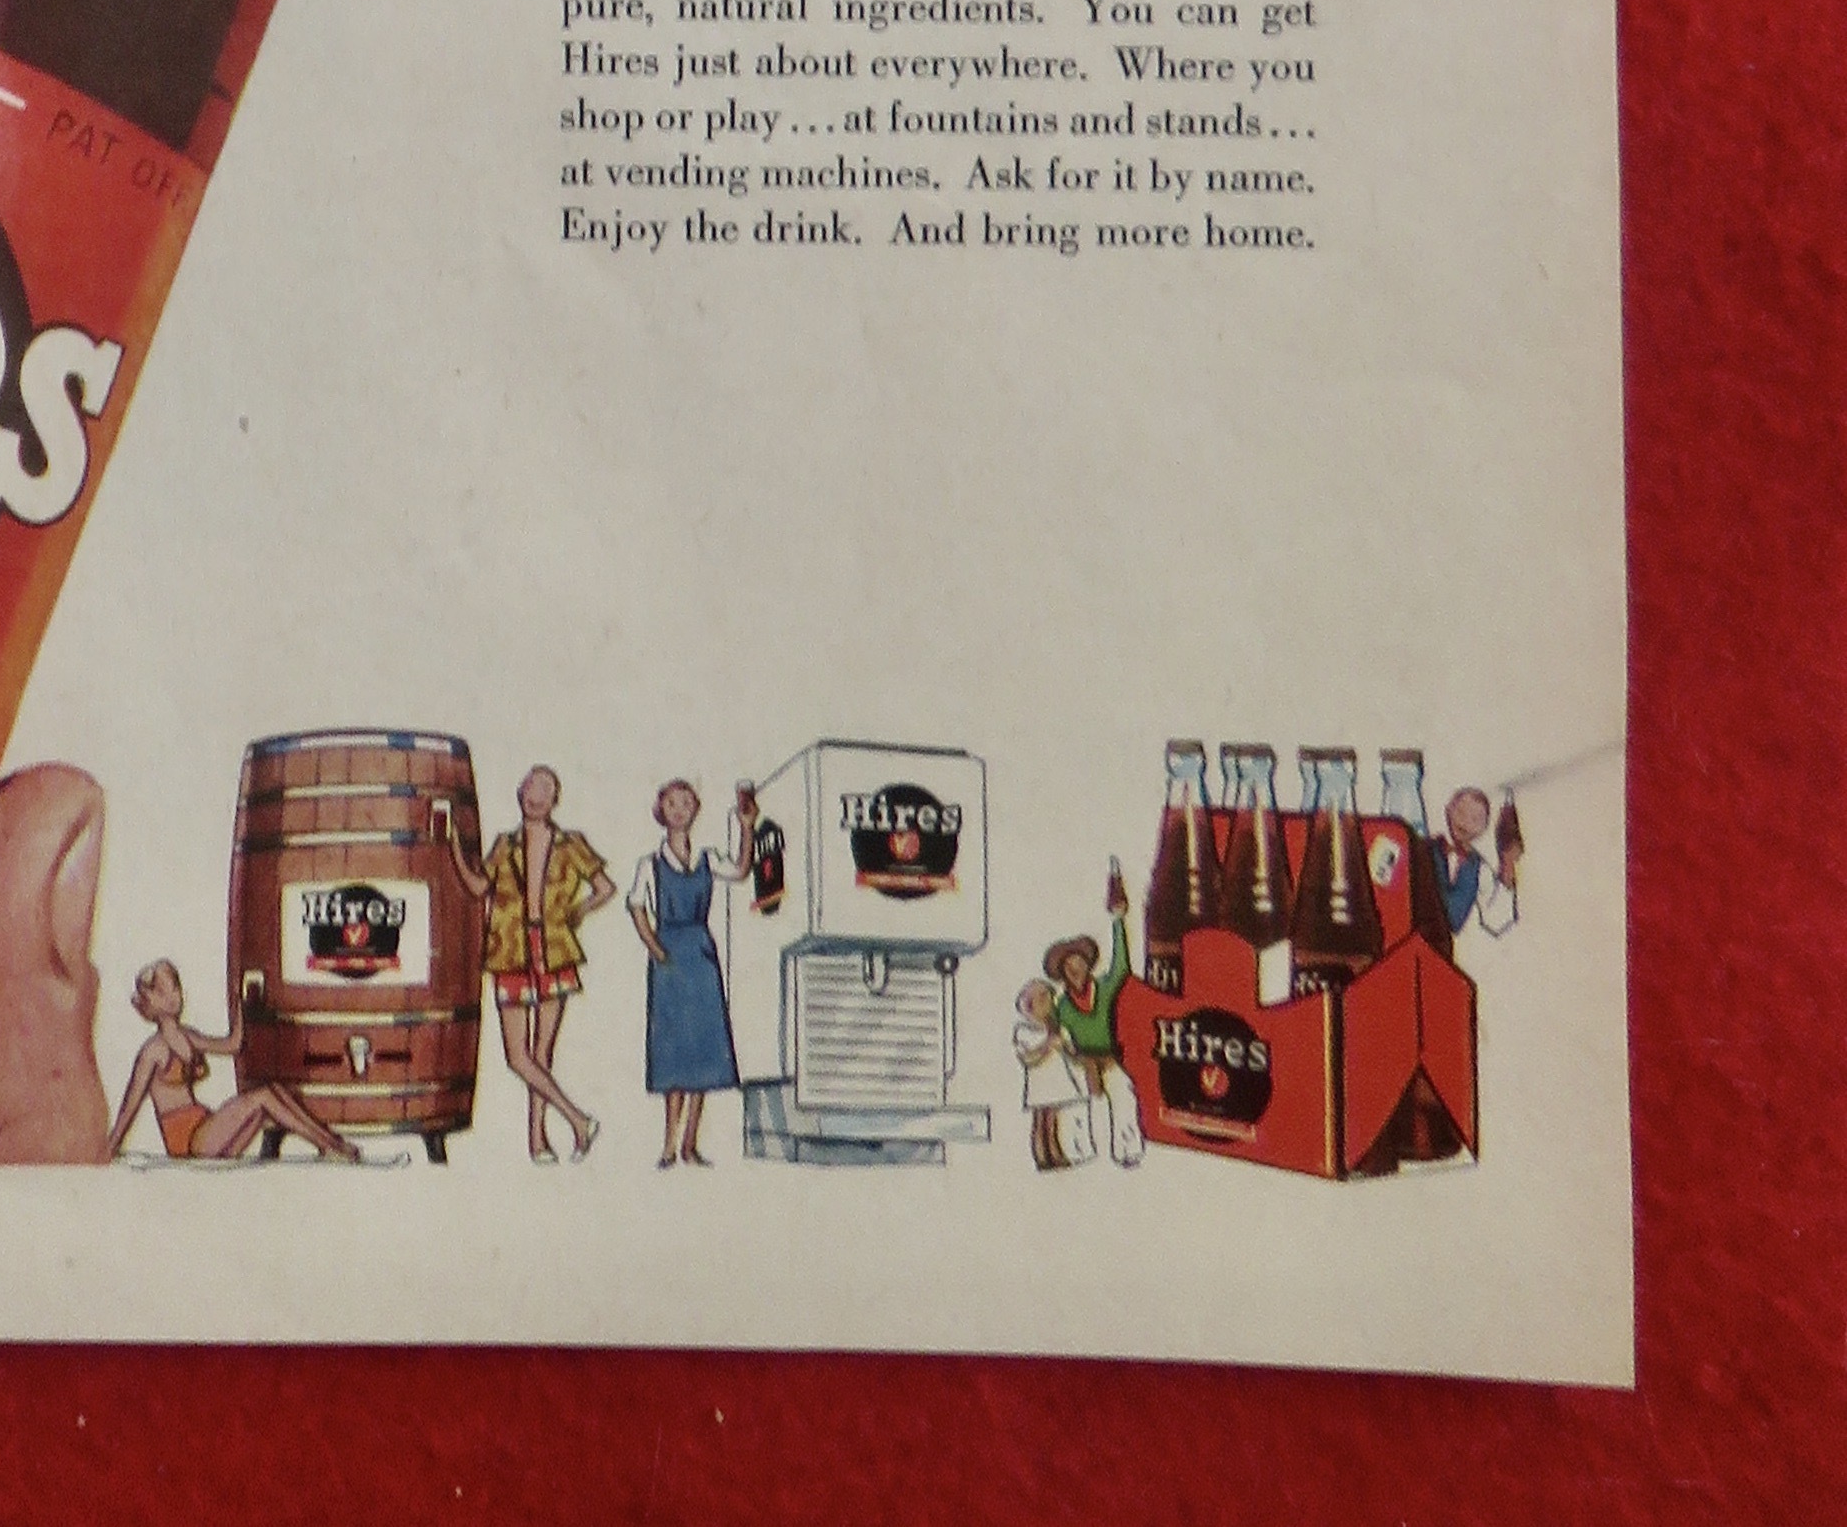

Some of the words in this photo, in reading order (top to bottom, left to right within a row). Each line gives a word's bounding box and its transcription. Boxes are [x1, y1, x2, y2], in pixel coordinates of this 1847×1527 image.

[1176, 3, 1239, 27] can
[1261, 0, 1317, 36] get
[561, 40, 660, 76] Hires
[672, 42, 741, 87] just
[755, 42, 857, 78] about
[870, 44, 1088, 90] everywhere.
[1114, 45, 1235, 81] Where
[1249, 59, 1316, 93] you
[46, 106, 124, 165] PAT
[559, 95, 645, 142] shop
[655, 109, 694, 132] or
[705, 97, 782, 144] play
[843, 105, 877, 134] at
[889, 98, 1059, 135] fountains
[1069, 100, 1135, 137] and
[560, 158, 594, 187] at
[605, 152, 750, 198] vending
[761, 154, 941, 191] machines.
[966, 154, 1034, 191] Ask
[1046, 155, 1101, 191] for
[1113, 158, 1138, 192] it
[1149, 157, 1193, 202] by
[1206, 170, 1315, 194] name.
[561, 206, 668, 254] Enjoy
[684, 207, 739, 245] the
[752, 209, 862, 246] drink.
[889, 210, 966, 246] And
[982, 211, 1080, 257] bring
[1096, 224, 1190, 248] more
[1204, 212, 1315, 250] home.
[841, 792, 962, 835] Hires
[301, 890, 407, 927] Hires
[1156, 1018, 1270, 1072] Hires
